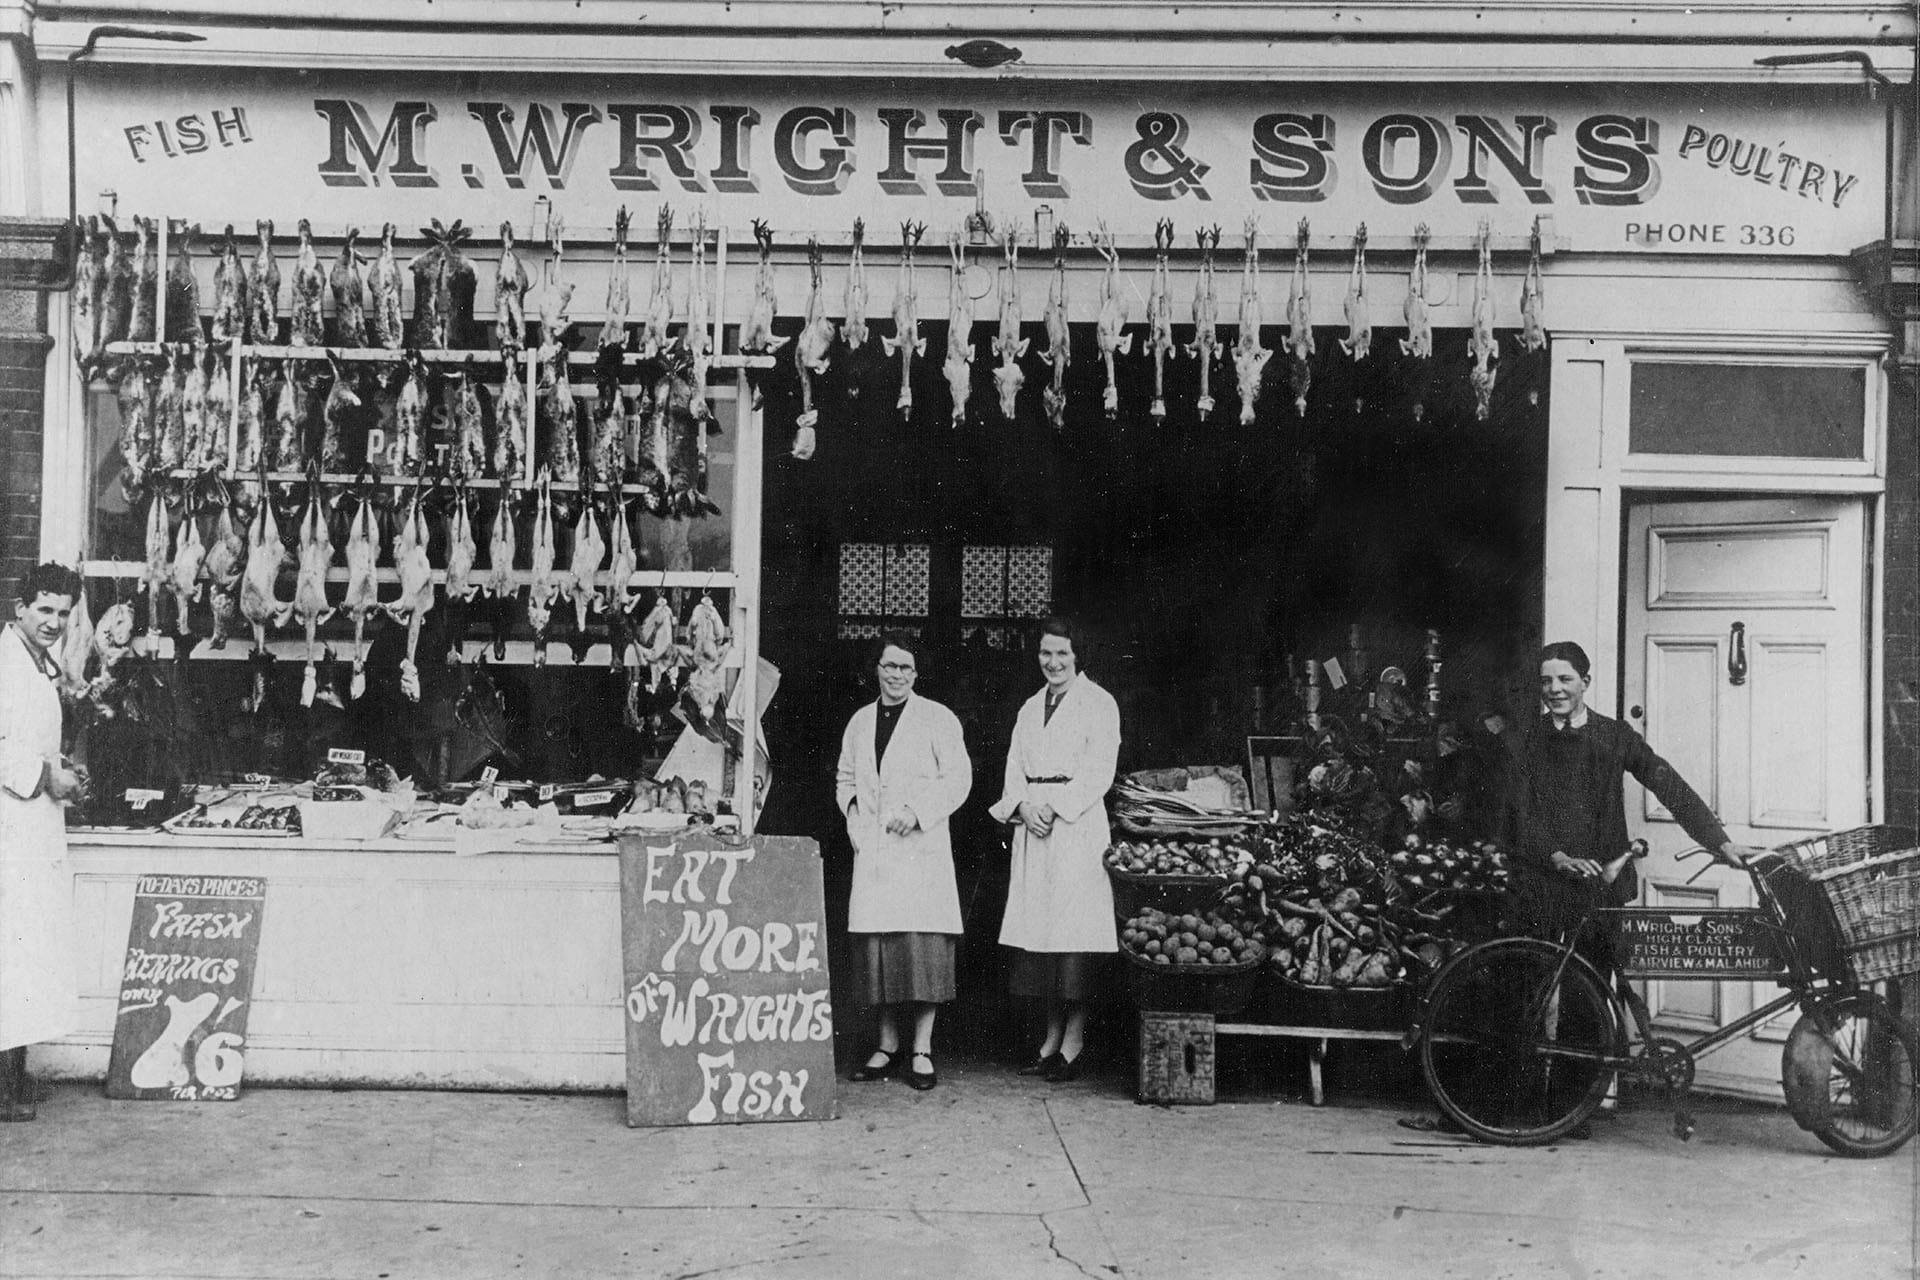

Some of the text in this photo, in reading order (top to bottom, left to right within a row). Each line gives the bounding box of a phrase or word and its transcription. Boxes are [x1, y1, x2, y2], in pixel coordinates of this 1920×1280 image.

[123, 106, 254, 163] FISH
[1124, 111, 1213, 201] &
[1250, 113, 1663, 206] SONS
[1625, 223, 1796, 246] PHONE 336
[200, 878, 259, 897] PRICES
[643, 843, 756, 908] EAT
[150, 901, 253, 939] FRESH
[1694, 924, 1703, 934] &
[1706, 920, 1743, 935] SONS
[661, 909, 820, 973] MORE
[1634, 944, 1755, 957] FISH & POULTRY
[1646, 934, 1732, 945] HIGH CLASS
[124, 948, 240, 985] HERRINGS
[1630, 956, 1694, 969] FAIRVIEW
[659, 977, 832, 1047] WRIGHTS
[687, 1050, 809, 1124] FISH
